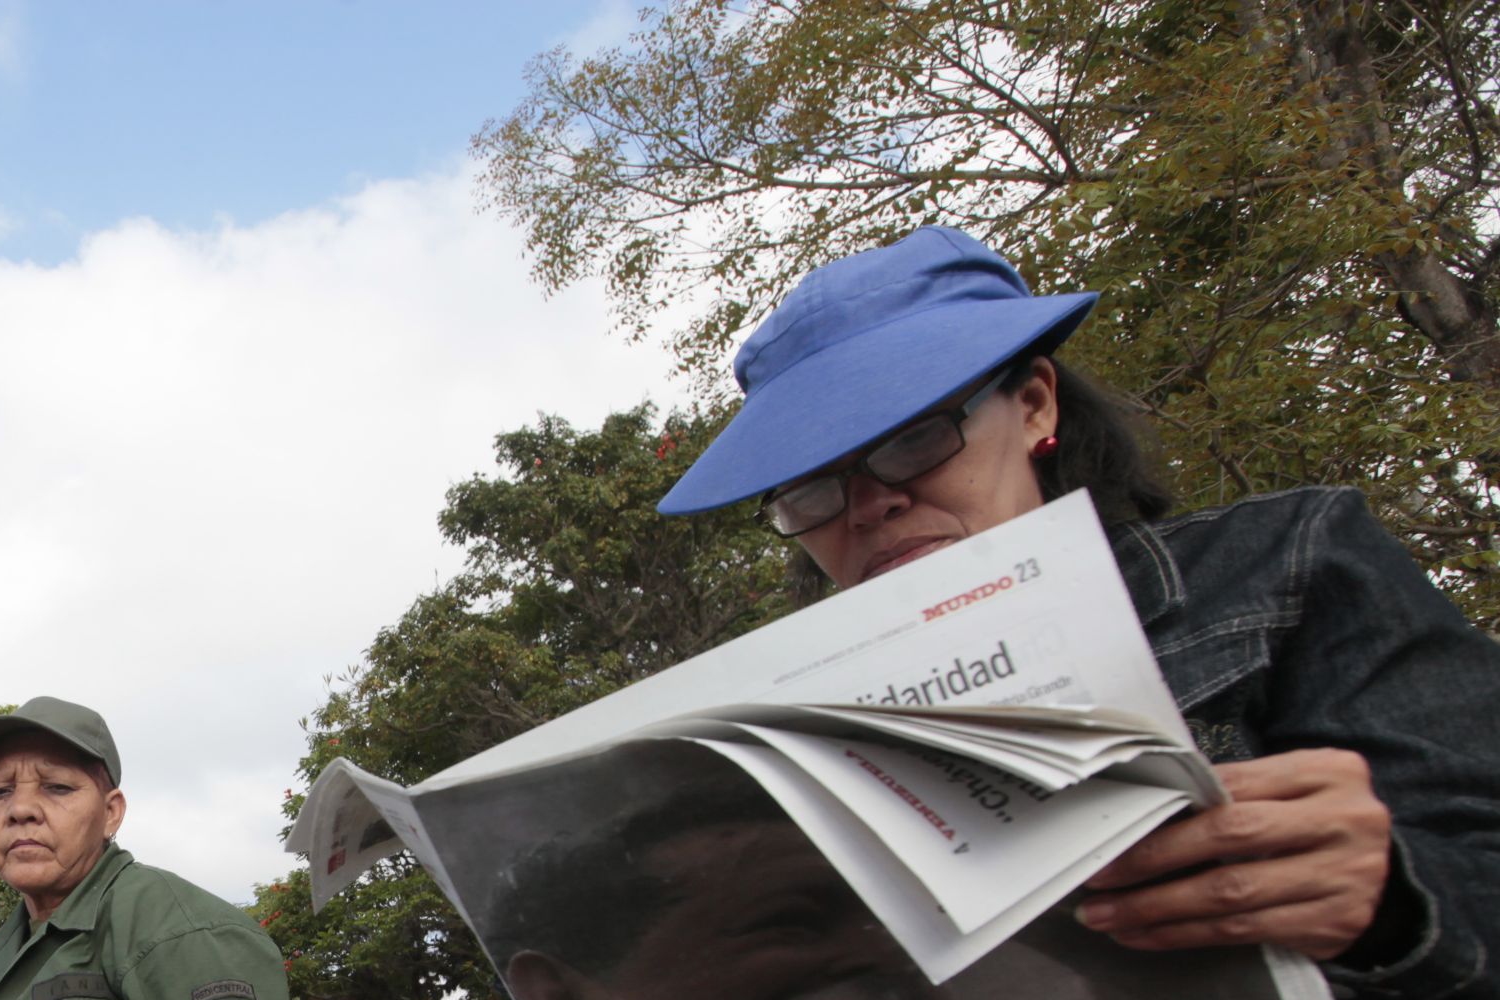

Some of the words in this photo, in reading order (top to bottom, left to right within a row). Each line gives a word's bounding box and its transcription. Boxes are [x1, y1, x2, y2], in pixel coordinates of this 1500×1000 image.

[921, 576, 1013, 622] MUNDO
[1014, 557, 1041, 583] 23
[845, 749, 955, 841] VENEZUELA
